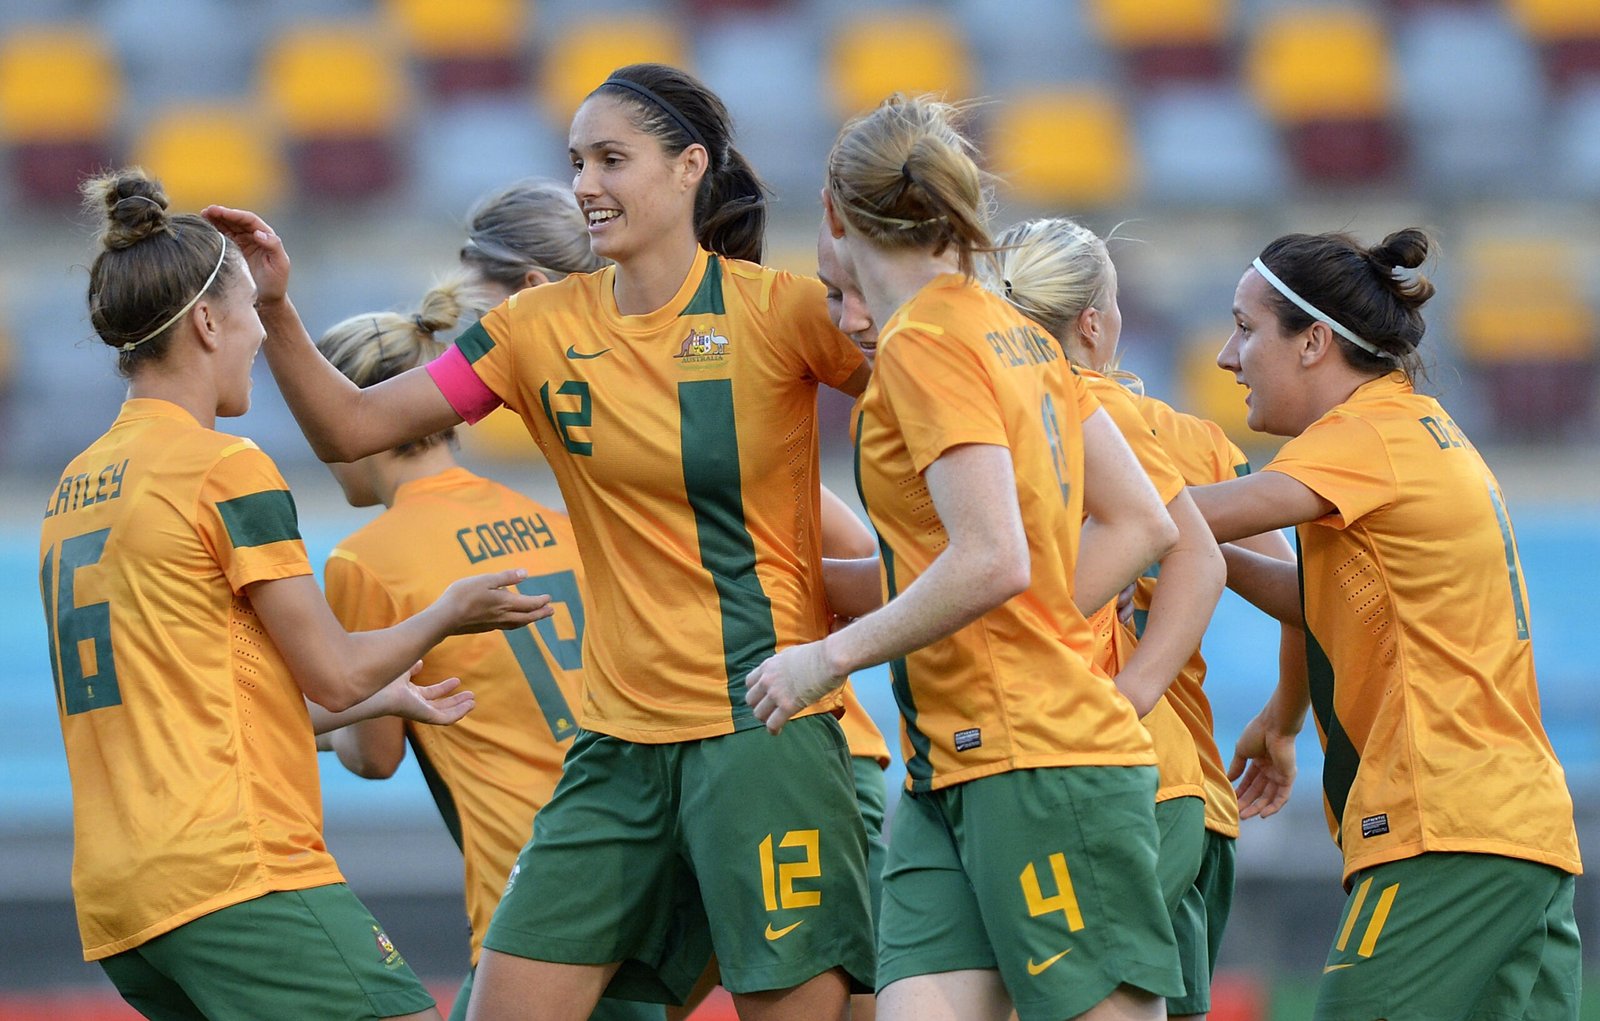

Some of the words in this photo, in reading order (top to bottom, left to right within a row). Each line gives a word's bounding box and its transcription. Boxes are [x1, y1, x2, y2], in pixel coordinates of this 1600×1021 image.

[682, 355, 723, 363] AUSTRALIA
[539, 379, 593, 457] 12
[456, 512, 558, 565] GORRY
[40, 527, 123, 716] 16
[758, 828, 822, 912] 12
[1019, 851, 1085, 933] 4
[1335, 876, 1400, 958] 11
